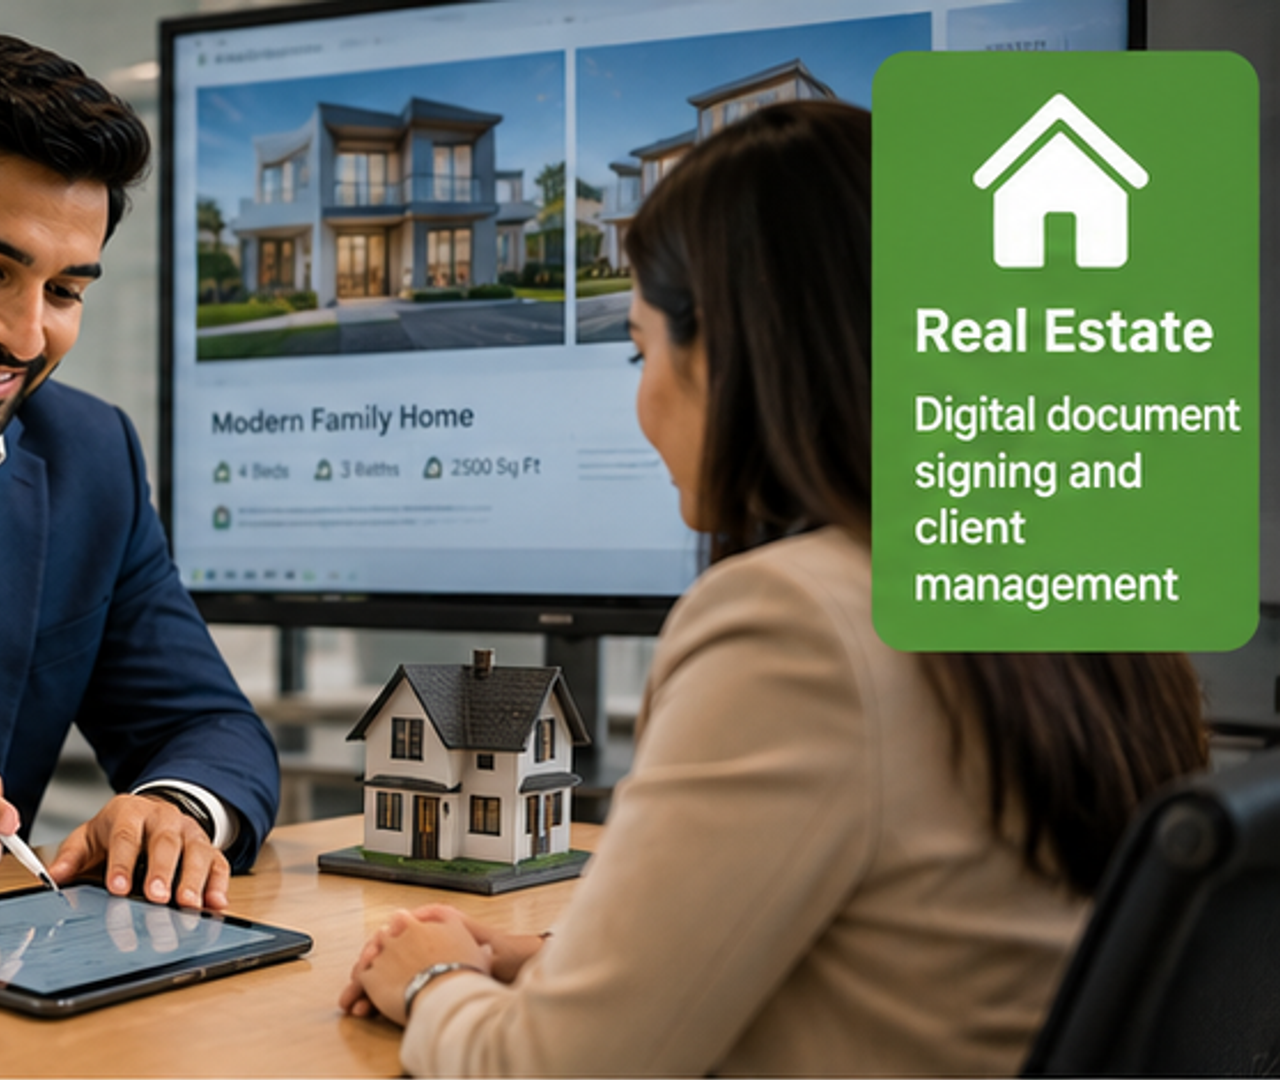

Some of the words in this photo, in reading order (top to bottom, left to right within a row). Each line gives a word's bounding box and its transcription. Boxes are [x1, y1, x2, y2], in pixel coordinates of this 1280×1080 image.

[211, 410, 304, 434] Modern
[312, 404, 392, 437] Family
[399, 404, 474, 429] Home
[340, 460, 351, 478] 3
[450, 458, 492, 476] 2500
[497, 457, 518, 479] Sq
[523, 456, 541, 475] Ft
